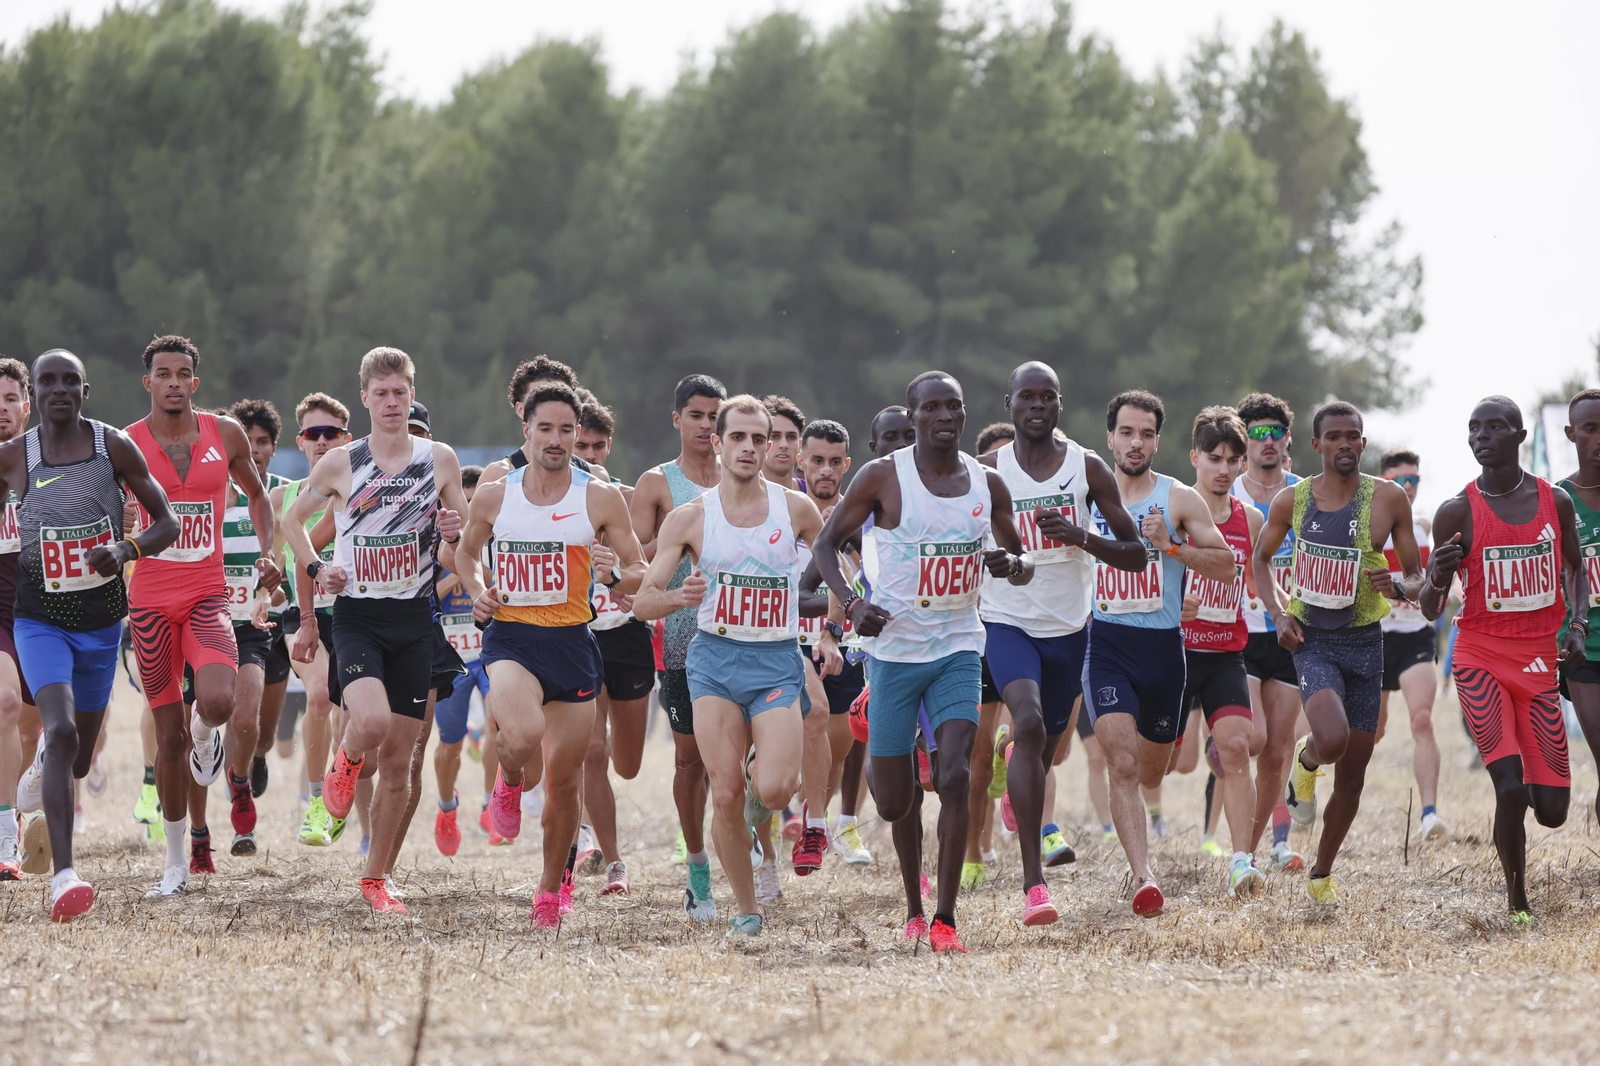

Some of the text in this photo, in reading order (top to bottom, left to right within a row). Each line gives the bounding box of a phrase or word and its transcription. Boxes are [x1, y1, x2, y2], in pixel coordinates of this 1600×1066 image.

[365, 477, 420, 488] saucony
[172, 504, 199, 514] TÁLICA
[61, 527, 97, 539] ITÁLICA
[512, 542, 546, 552] ITÁLICA
[941, 543, 974, 554] ITÁLICA
[1309, 546, 1341, 558] ITÁLICA
[1504, 547, 1538, 558] ITÁLICA
[354, 541, 418, 582] VANOPPEN
[497, 553, 565, 592] FONTES
[918, 552, 982, 597] KOECH
[1295, 548, 1355, 597] NDIKUMANA
[1487, 554, 1554, 599] ALAMISI
[736, 575, 772, 588] ITÁLICA
[1096, 562, 1161, 601] AOUINA
[714, 585, 789, 628] ALFIERI
